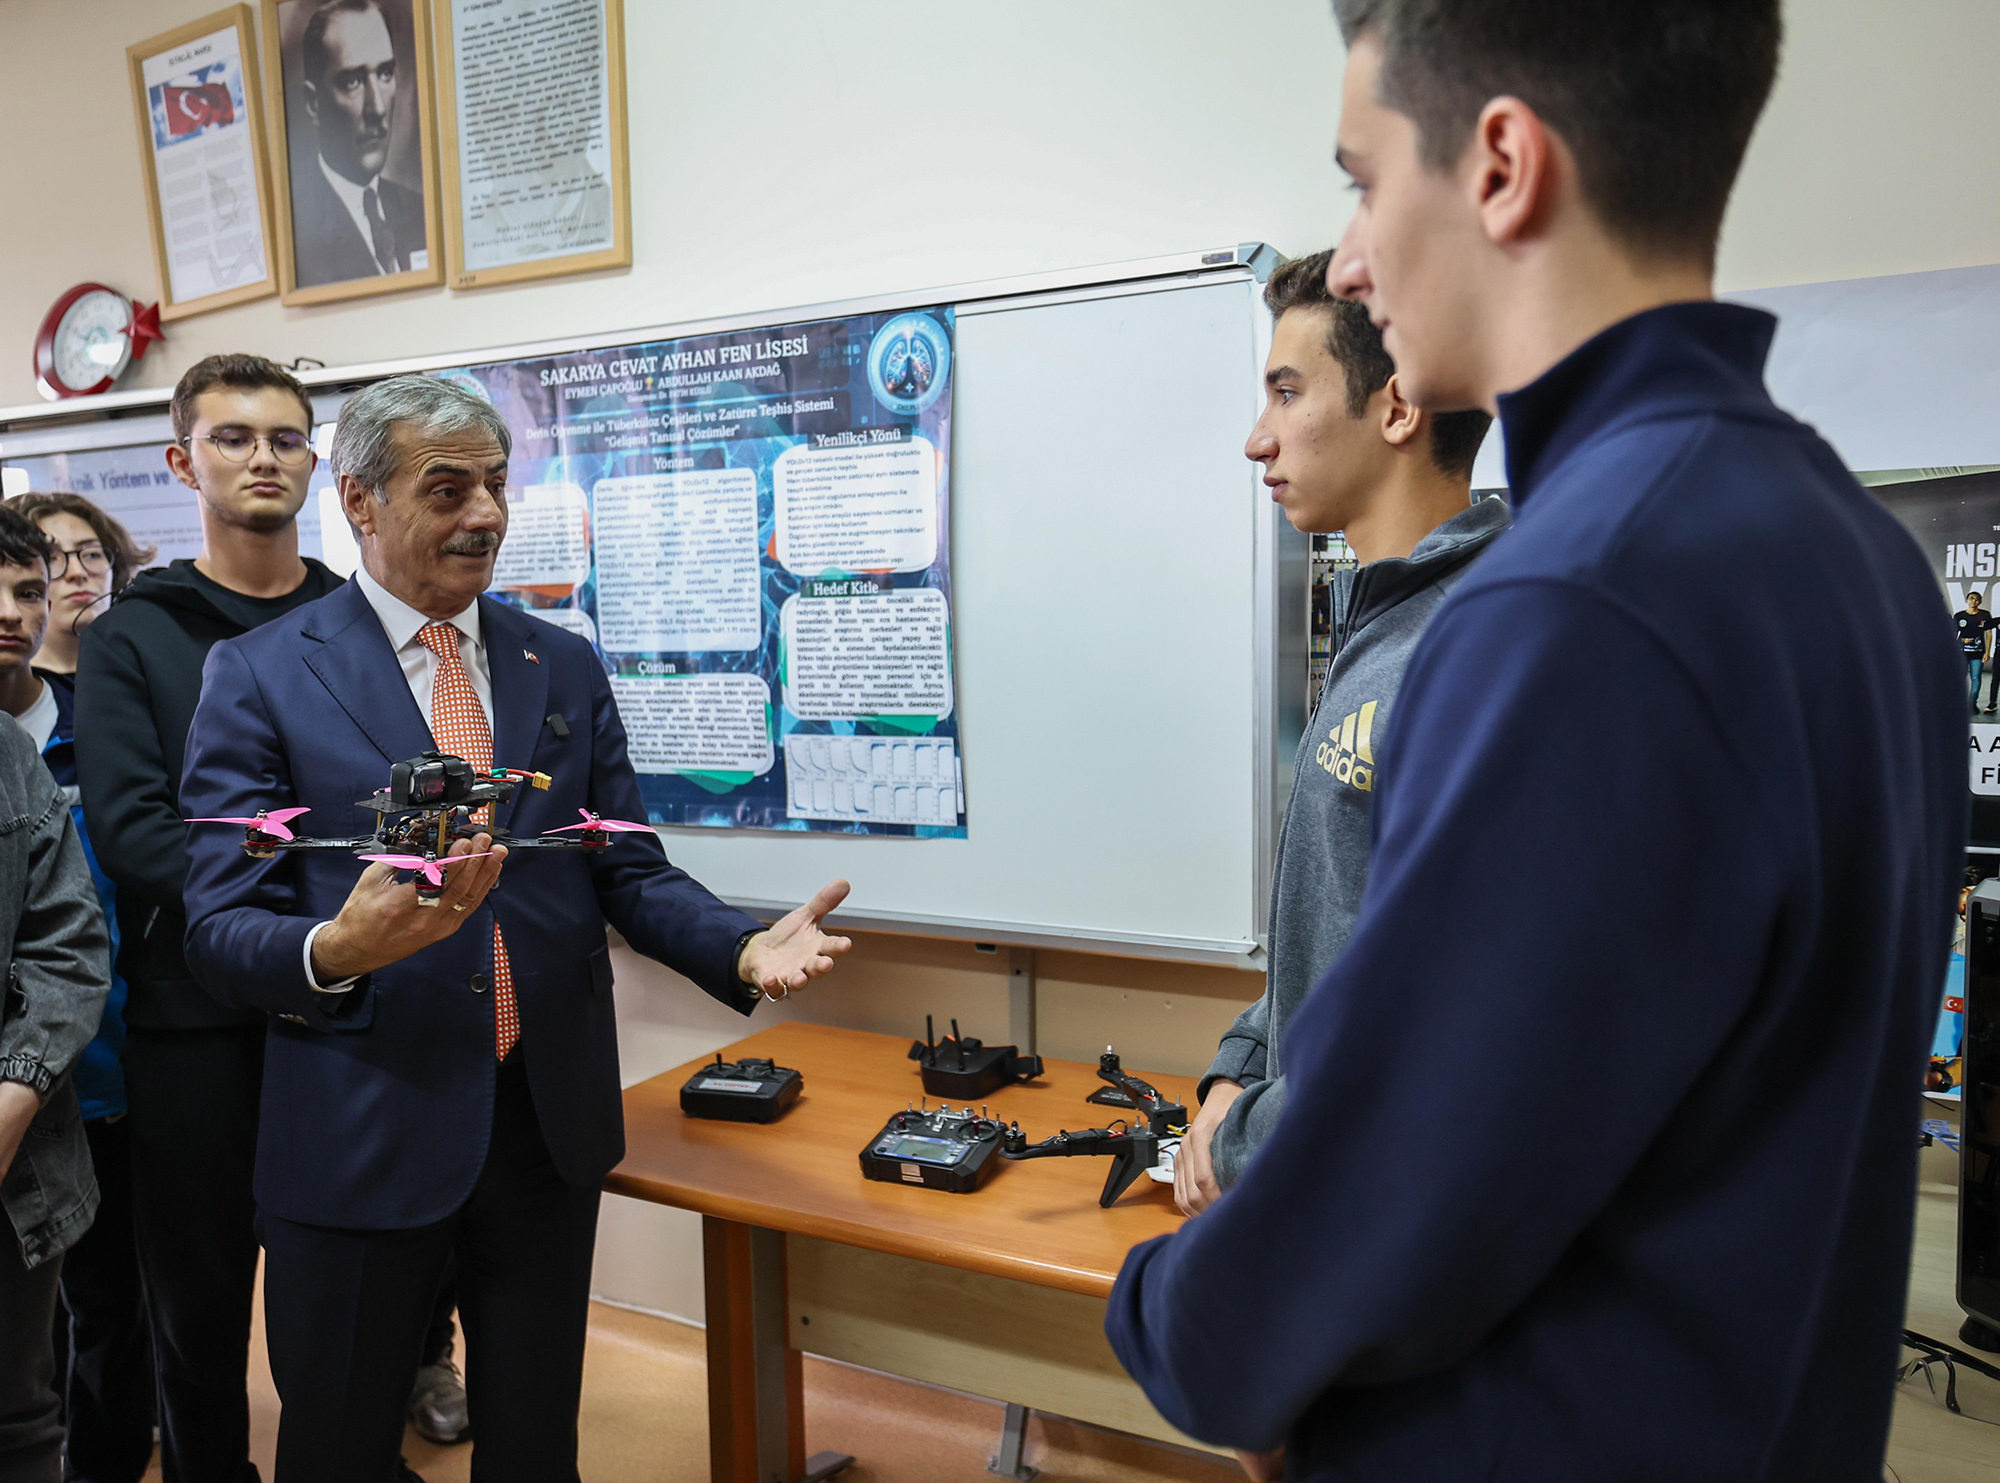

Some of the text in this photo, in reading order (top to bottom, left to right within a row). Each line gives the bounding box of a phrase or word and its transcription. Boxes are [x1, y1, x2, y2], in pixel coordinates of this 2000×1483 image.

[540, 335, 809, 387] SAKARYA CEVAT AYHAN FEN LİSESİ
[565, 362, 781, 400] EYMEN ÇAPOĞLU ABDULLAH KAAN AKDAĞ
[526, 427, 549, 440] Derin
[593, 423, 605, 433] ile
[607, 416, 660, 433] Tüberküloz
[660, 412, 702, 429] Çeşitleri
[704, 412, 718, 423] ve
[718, 407, 757, 420] Zatürre
[758, 402, 793, 418] Teşhis
[795, 397, 835, 413] Sistemi
[650, 430, 686, 444] Tanısal
[687, 424, 741, 443] Çözümler"
[816, 428, 901, 448] Yenilikçi Yönü
[864, 452, 884, 460] yüksek
[653, 457, 695, 470] Yöntem
[98, 469, 151, 490] Yöntem
[153, 471, 171, 486] ve
[890, 469, 920, 477] sistemde
[853, 509, 883, 518] sayesinde
[824, 520, 840, 528] kolay
[856, 548, 886, 556] sayesinde
[813, 581, 879, 596] Hedef Kitle
[637, 662, 676, 676] Çözüm
[887, 673, 914, 681] personel
[1316, 741, 1378, 792] adida
